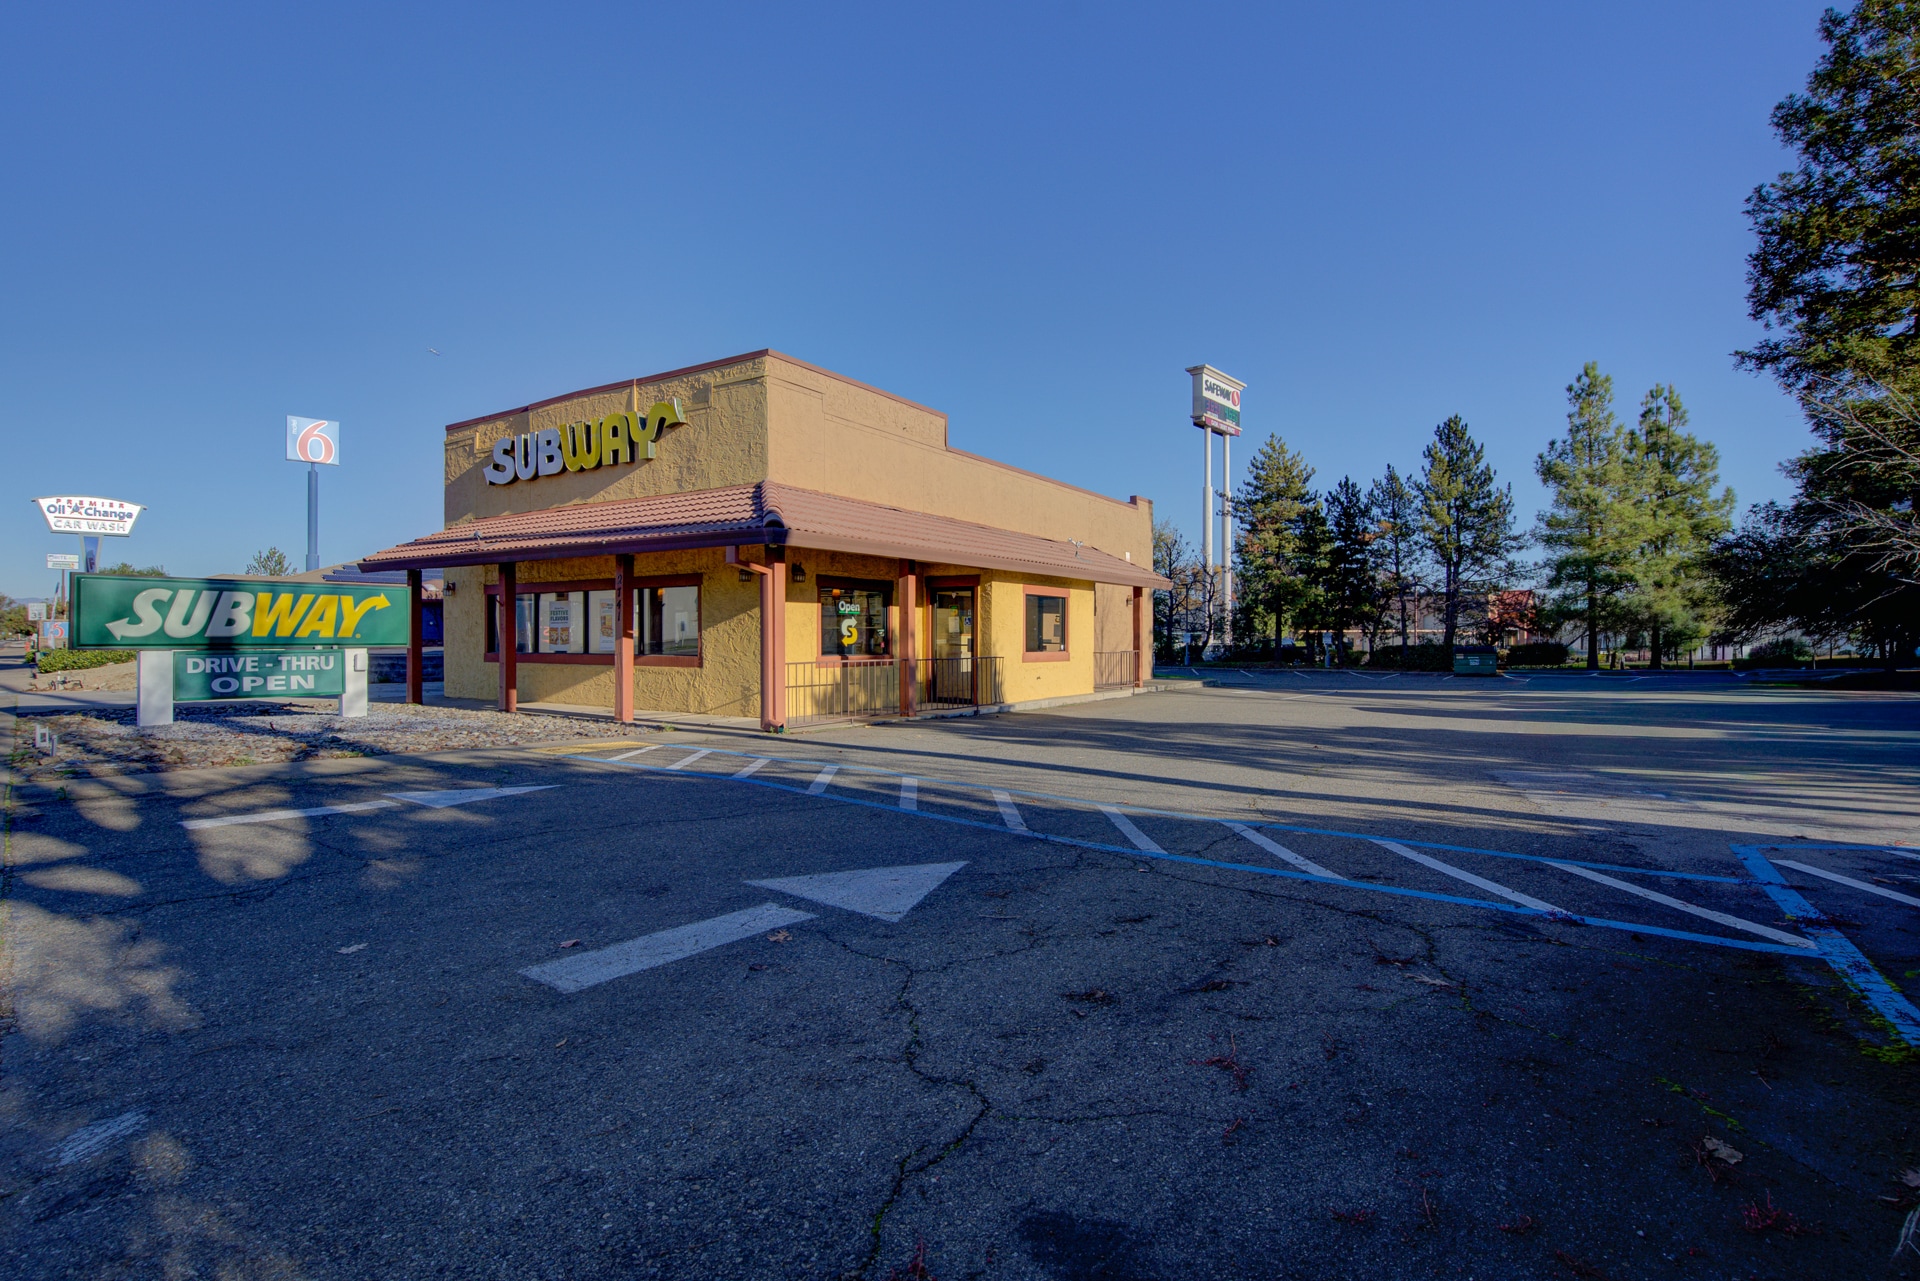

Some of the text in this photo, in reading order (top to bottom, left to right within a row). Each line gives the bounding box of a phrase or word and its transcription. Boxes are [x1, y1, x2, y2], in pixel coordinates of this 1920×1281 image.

[1204, 379, 1231, 401] SAFEWAY
[296, 420, 335, 463] 6
[483, 398, 688, 485] SUBWAY
[46, 504, 133, 520] Oil Change
[56, 498, 124, 508] PREMIER
[54, 519, 126, 531] CAR WASH
[105, 588, 391, 641] SUBWAY
[838, 601, 860, 613] Open
[186, 656, 259, 674] DRIVE
[278, 655, 335, 671] THRU
[211, 674, 315, 693] OPEN
